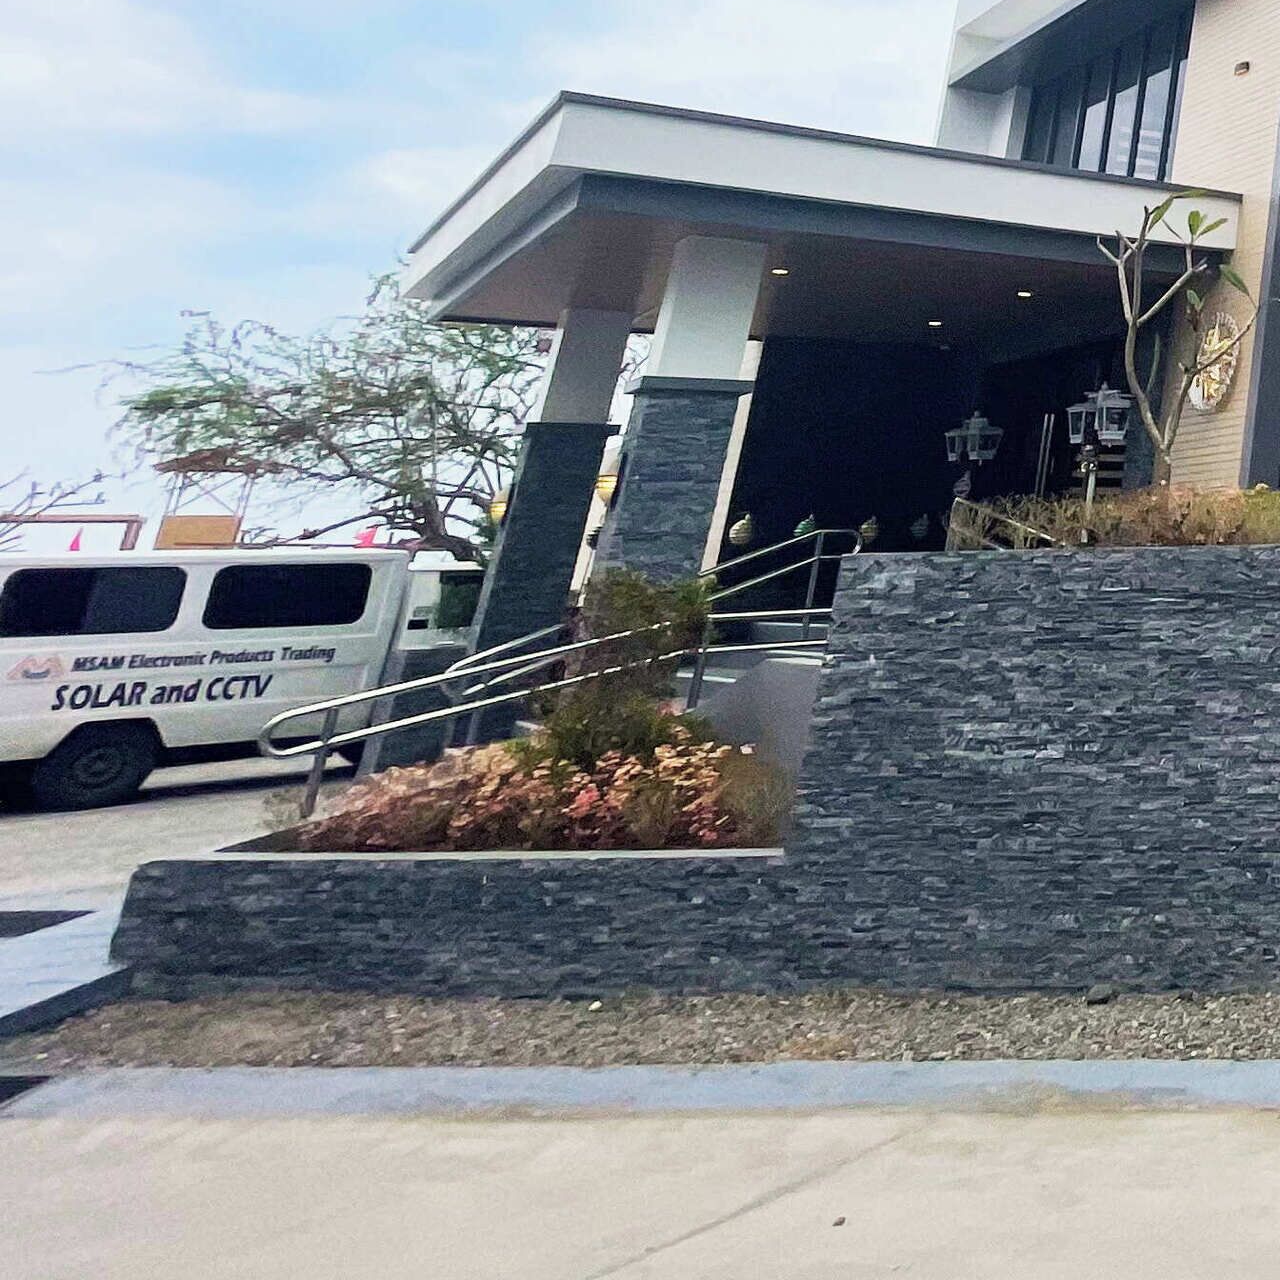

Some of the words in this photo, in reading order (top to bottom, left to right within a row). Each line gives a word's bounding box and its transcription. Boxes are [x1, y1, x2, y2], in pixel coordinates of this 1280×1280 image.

[128, 651, 206, 669] Electronic
[209, 649, 275, 664] Products
[281, 646, 336, 663] Trading
[51, 682, 147, 711] SOLAR
[150, 679, 202, 705] and
[206, 675, 273, 701] CCTV
